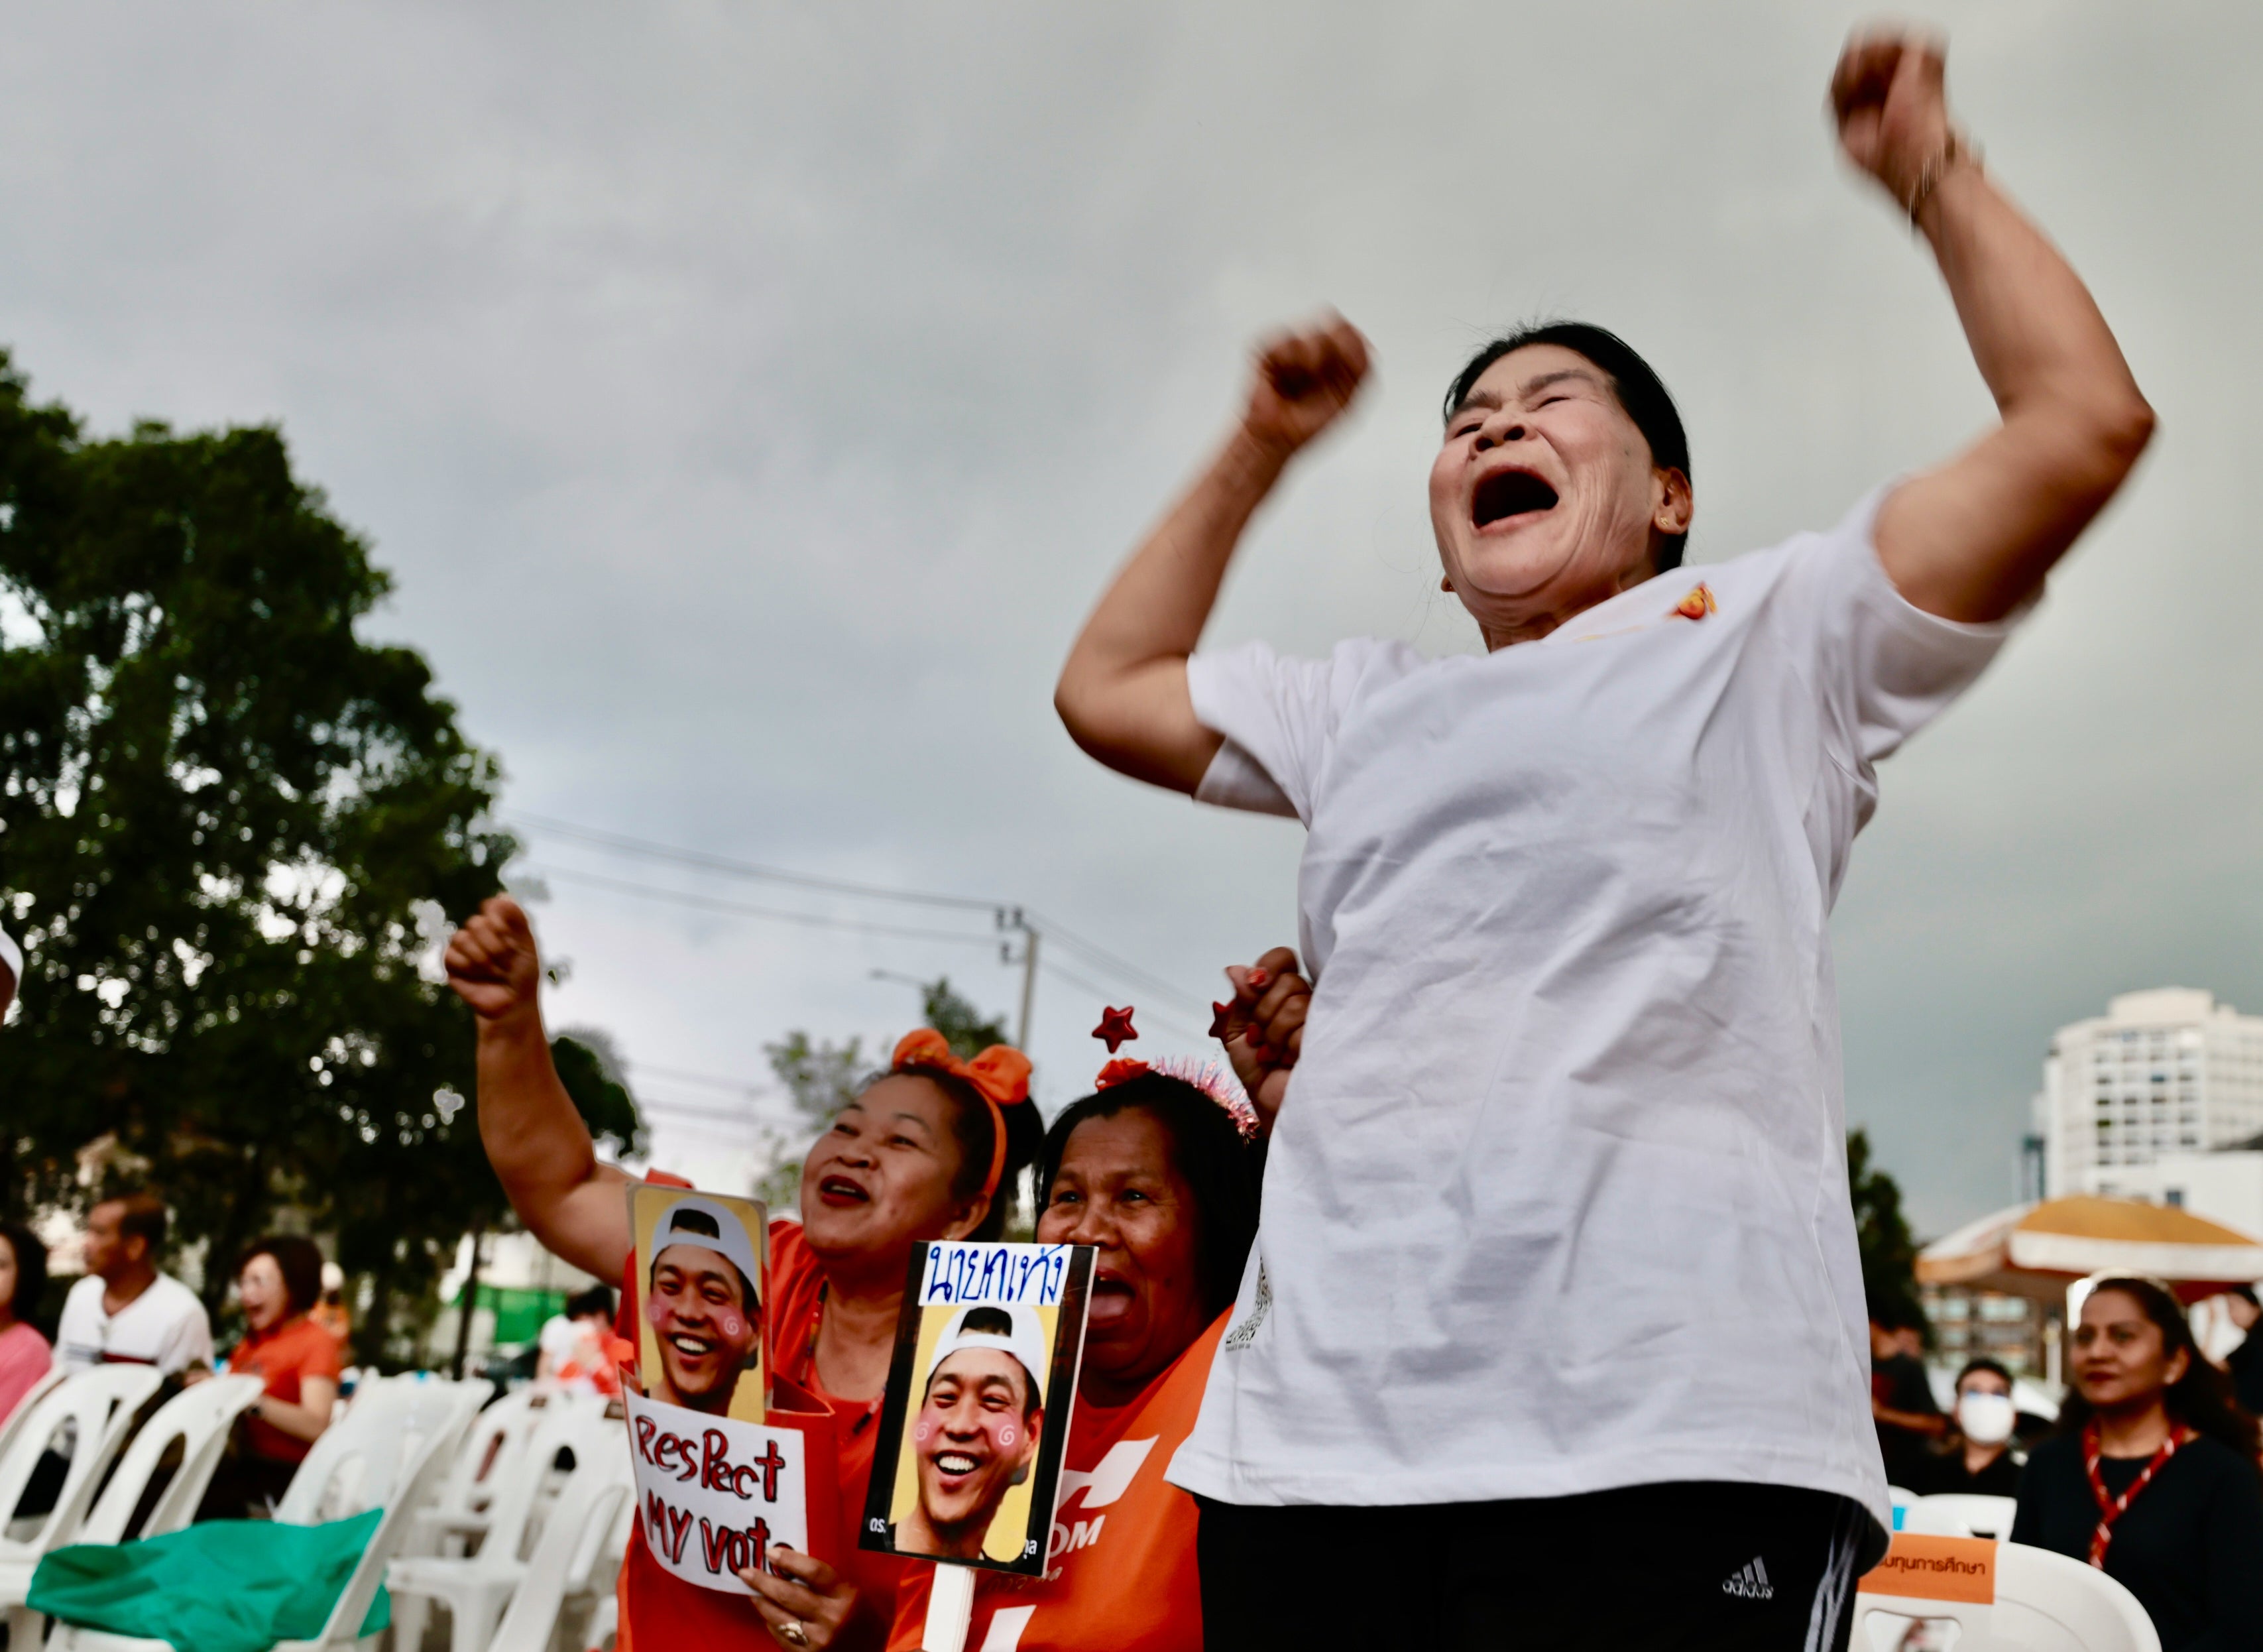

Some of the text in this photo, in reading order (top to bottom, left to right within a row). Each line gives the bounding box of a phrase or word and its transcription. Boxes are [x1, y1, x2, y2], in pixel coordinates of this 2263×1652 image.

[1881, 1556, 1986, 1575] บทุนการศึกษา
[1723, 1578, 1774, 1600] adidas
